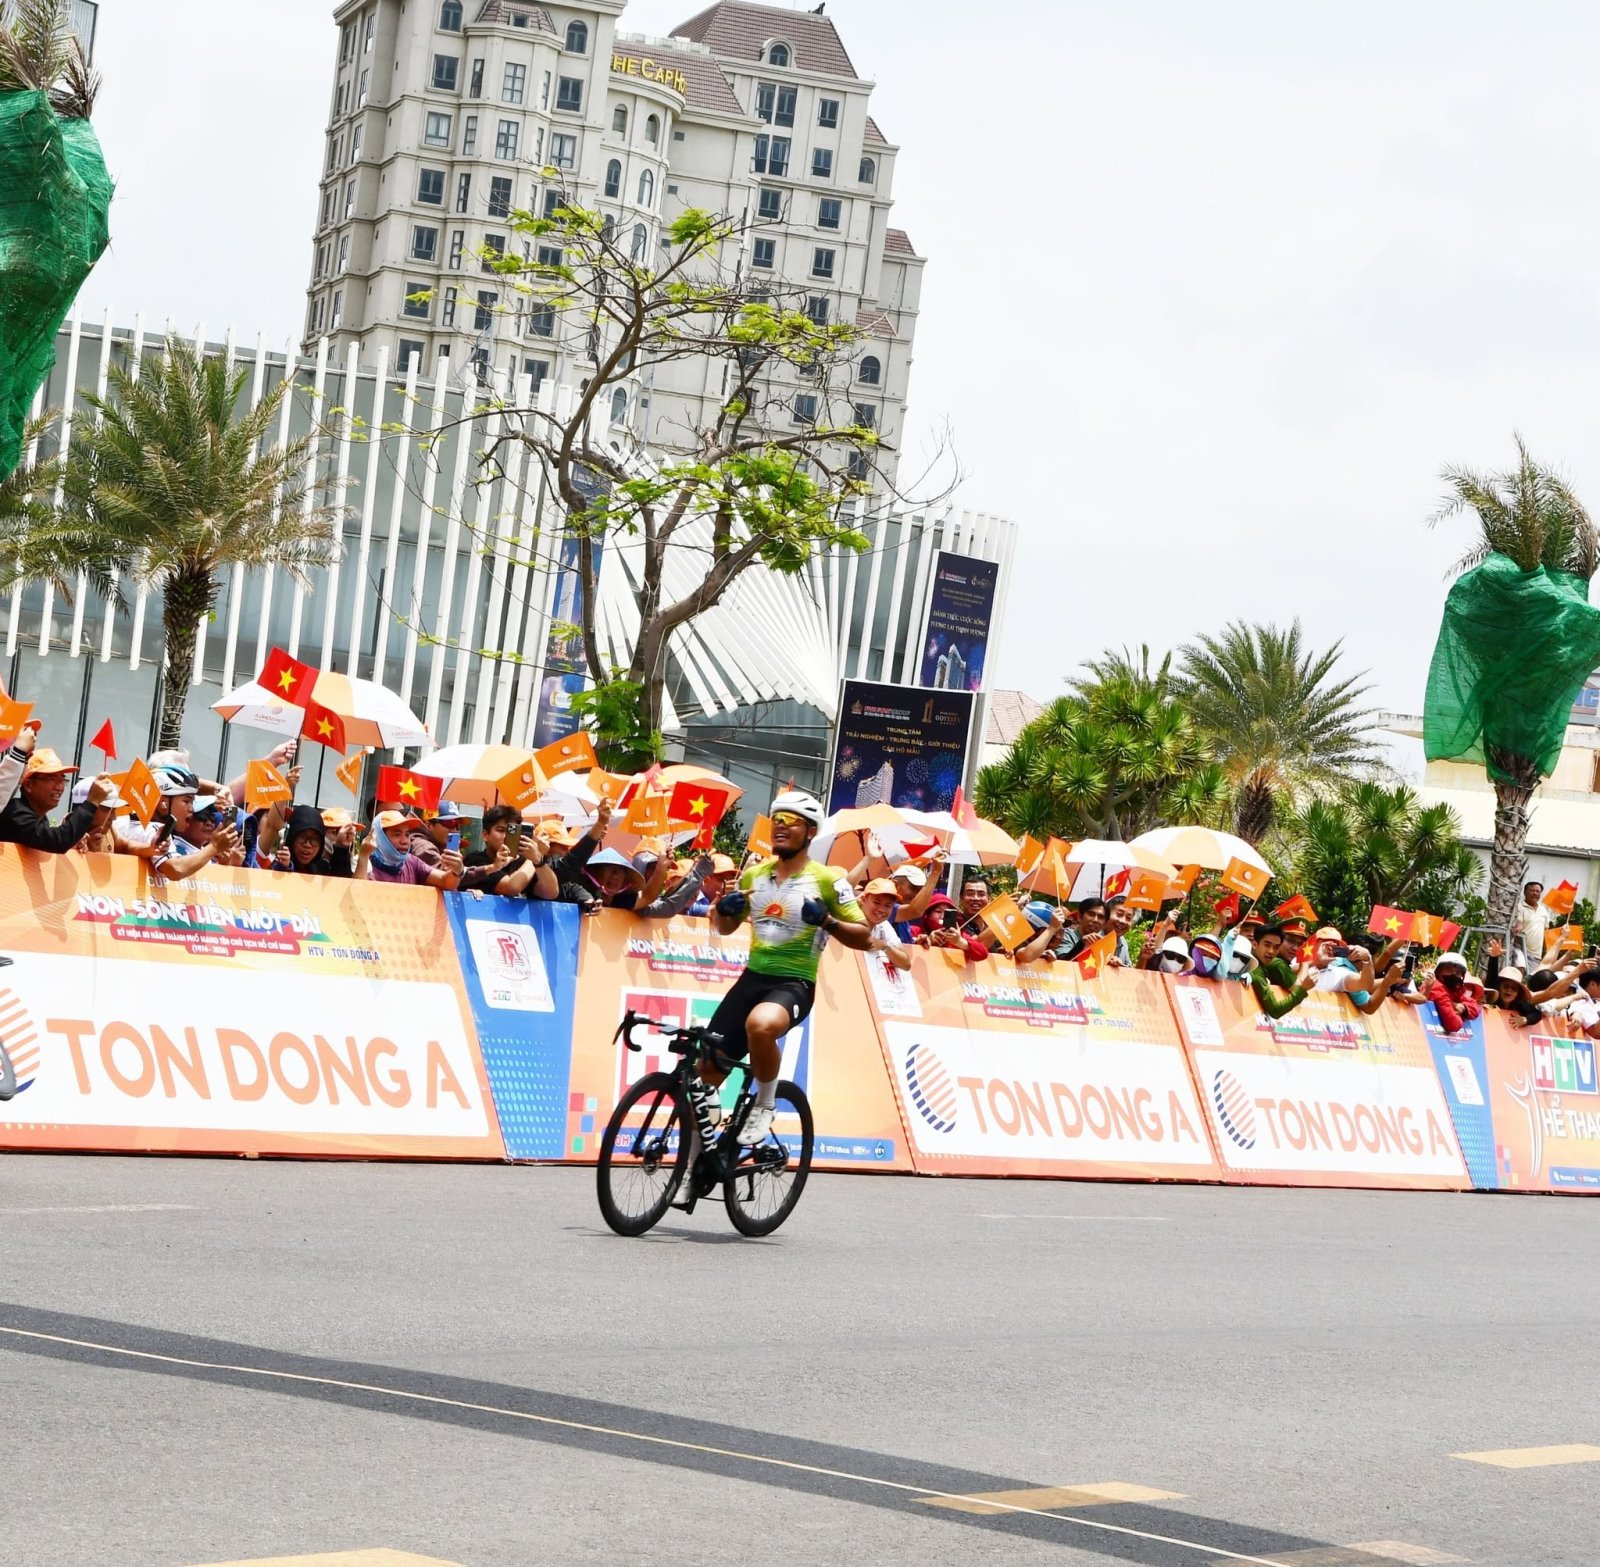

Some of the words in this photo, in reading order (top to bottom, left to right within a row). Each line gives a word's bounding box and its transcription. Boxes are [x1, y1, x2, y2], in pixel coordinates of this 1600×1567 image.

[76, 893, 127, 918] NON
[240, 905, 284, 936] MỘT
[308, 946, 325, 957] HTV
[627, 938, 656, 954] NON
[963, 983, 991, 999] NON
[47, 1018, 211, 1101] TON
[215, 1027, 412, 1110] DONG
[427, 1040, 471, 1110] A
[1533, 1043, 1593, 1086] HTV
[692, 1076, 718, 1153] FACTOR
[958, 1076, 1053, 1138] TON
[1050, 1082, 1164, 1143] DONG
[1168, 1090, 1199, 1144] A
[1254, 1098, 1332, 1152] TON
[1328, 1102, 1423, 1157] DONG
[1428, 1107, 1454, 1158] A
